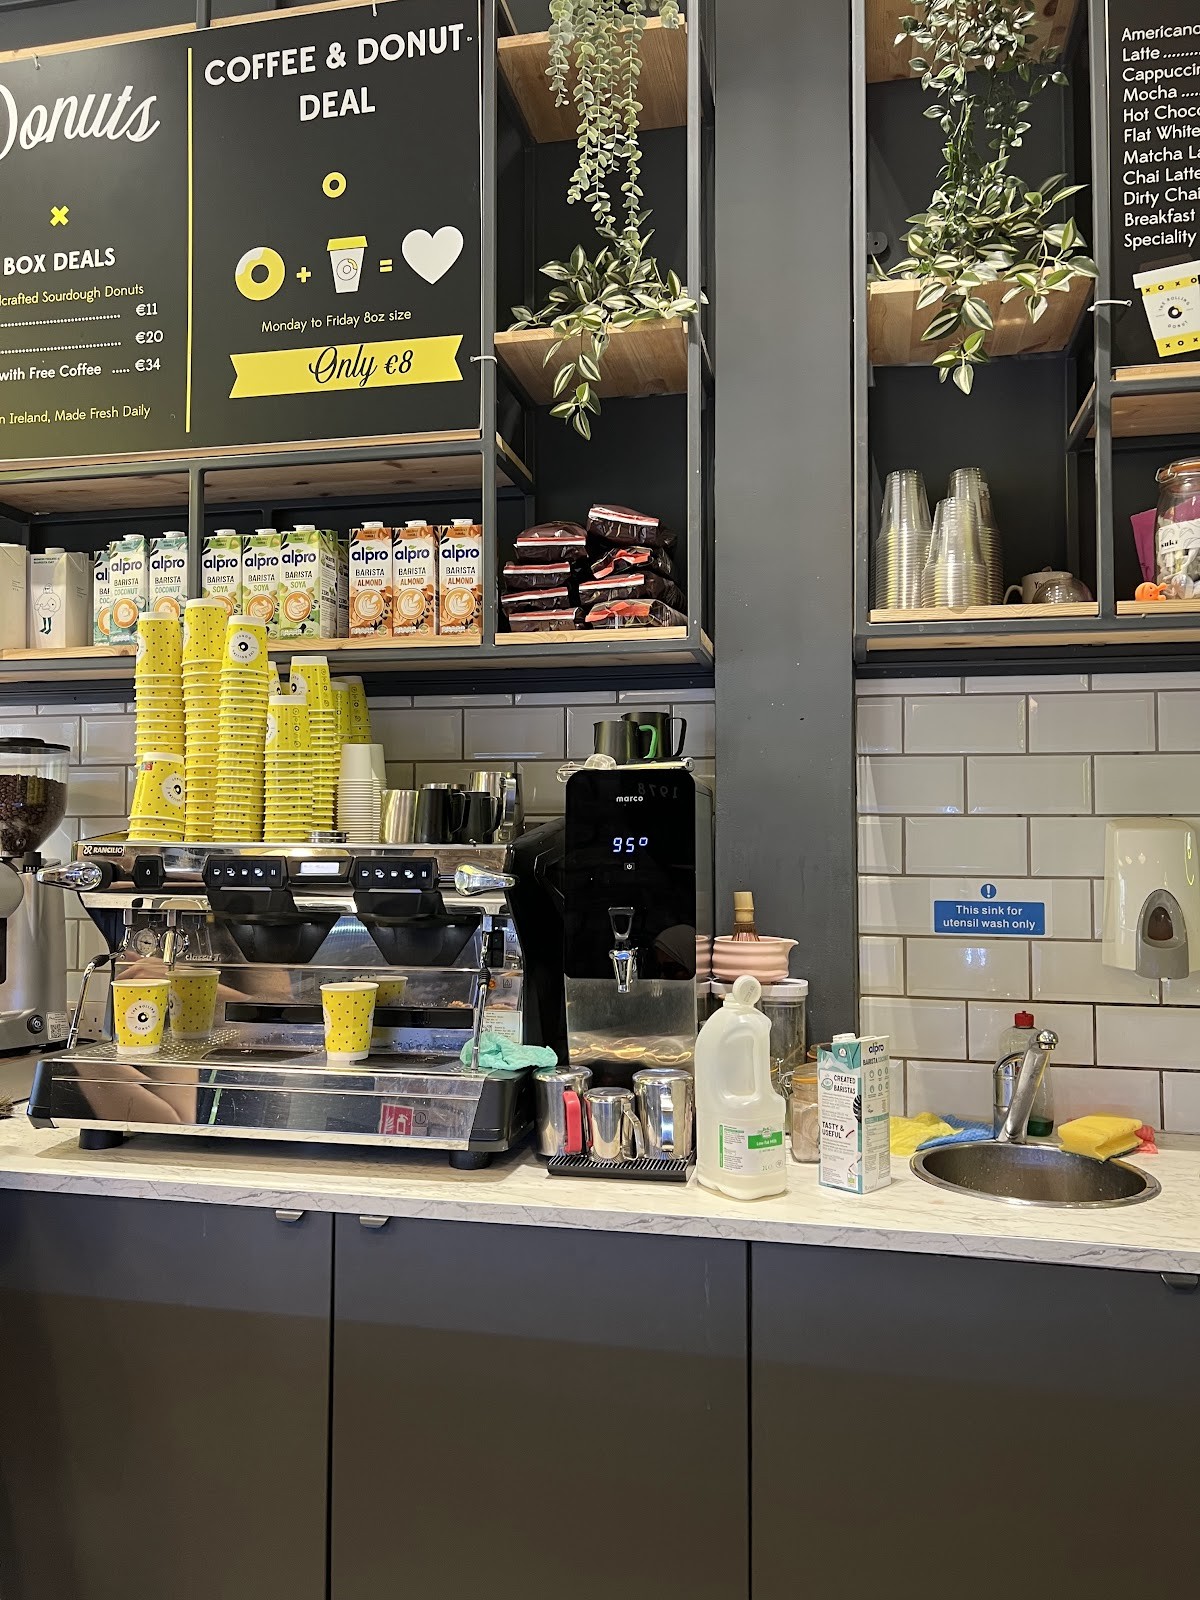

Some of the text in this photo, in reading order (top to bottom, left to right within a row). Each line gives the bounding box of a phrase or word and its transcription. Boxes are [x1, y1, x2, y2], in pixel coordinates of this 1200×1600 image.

[204, 23, 464, 86] COFFEE & DONUT
[1122, 46, 1161, 62] Latte
[1123, 84, 1178, 103] Mocha
[299, 86, 376, 122] DEAL
[1123, 107, 1150, 123] Hot
[1124, 123, 1200, 144] Flat White
[1123, 146, 1183, 165] Matcha
[1123, 169, 1160, 185] Chai
[1123, 190, 1160, 209] Dirty
[1124, 208, 1196, 227] Breakfast
[1123, 228, 1197, 251] Speciality
[3, 247, 116, 276] BOX DEALS
[42, 286, 101, 304] Sourdough
[104, 284, 145, 298] Donuts
[135, 302, 159, 317] €11
[261, 309, 412, 333] Monday to Friday 8oz size
[135, 330, 164, 345] €20
[0, 358, 162, 382] with Free Coffee €34
[308, 344, 414, 388] Only €8
[9, 410, 51, 425] Ireland,
[54, 409, 87, 422] Made
[90, 405, 119, 420] Fresh
[123, 403, 151, 420] Daily
[282, 549, 317, 567] alpro
[351, 546, 389, 565] alpro
[394, 545, 430, 564] alpro
[441, 544, 480, 562] alpro
[111, 558, 143, 575] alpro
[151, 555, 185, 572] alpro
[203, 555, 238, 572] alpro
[244, 553, 279, 571] alpro
[248, 574, 275, 582] BARISTA
[285, 570, 313, 579] BARISTA
[355, 568, 385, 577] BARISTA
[398, 567, 427, 576] BARISTA
[445, 566, 476, 575] BARISTA
[114, 577, 139, 587] BARISTA
[154, 575, 182, 585] BARISTA
[206, 575, 235, 584] BARISTA
[290, 580, 307, 589] SOYA
[357, 578, 383, 587] ALMOND
[400, 577, 424, 586] ALMOND
[447, 577, 474, 585] ALMOND
[114, 587, 138, 596] COCONUT
[154, 585, 181, 594] COCONUT
[212, 585, 229, 593] SOYA
[253, 584, 269, 592] SOYA
[616, 795, 644, 803] marco
[93, 846, 123, 854] RANCILIO
[955, 905, 1023, 916] This sink for
[943, 918, 1036, 931] utensil wash only
[868, 1042, 885, 1055] alpro
[862, 1057, 878, 1066] BARISTA
[833, 1074, 856, 1085] CREATED
[833, 1085, 856, 1095] BARISTAS
[822, 1121, 845, 1132] TASTY &
[822, 1128, 842, 1139] USEFUL
